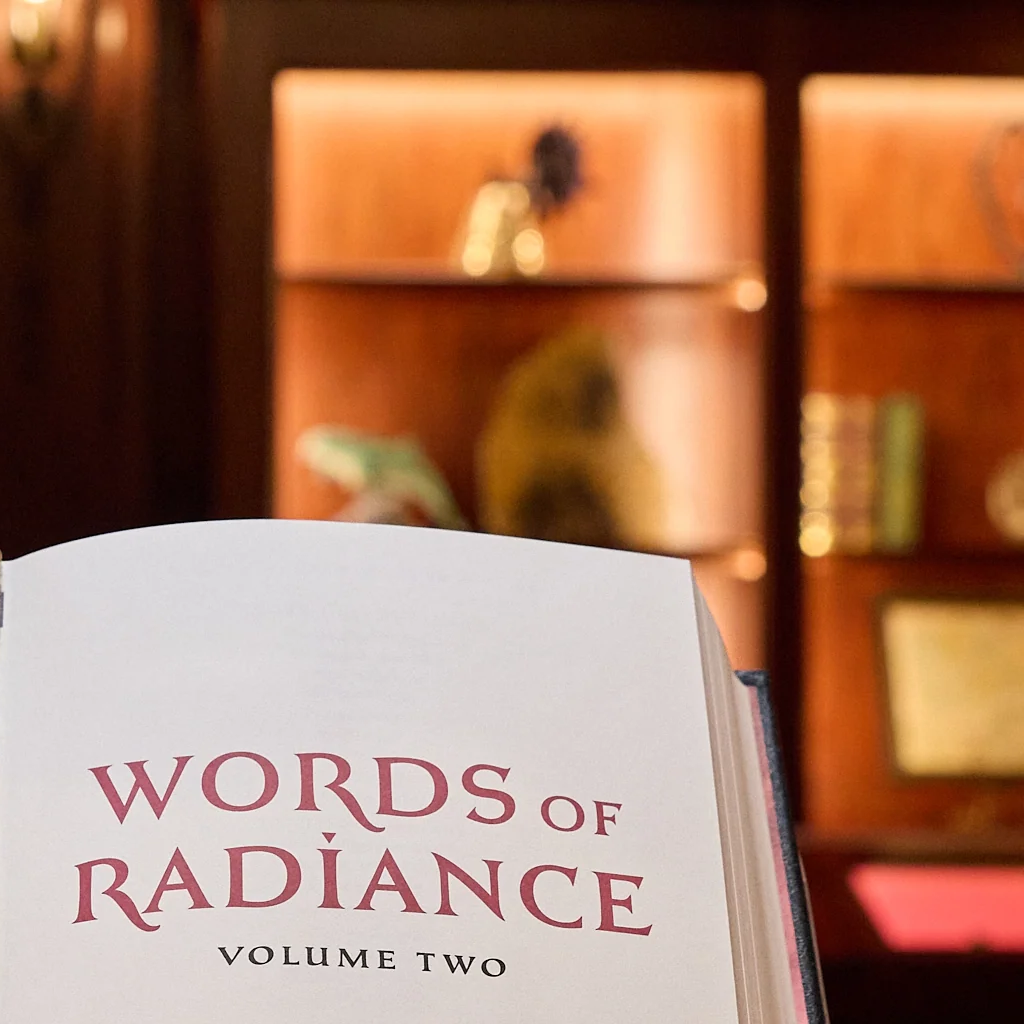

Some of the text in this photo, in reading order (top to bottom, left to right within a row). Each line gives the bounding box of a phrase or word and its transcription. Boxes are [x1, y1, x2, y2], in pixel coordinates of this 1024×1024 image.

[88, 750, 623, 837] WORDS OF
[217, 945, 507, 979] VOLUME TWO
